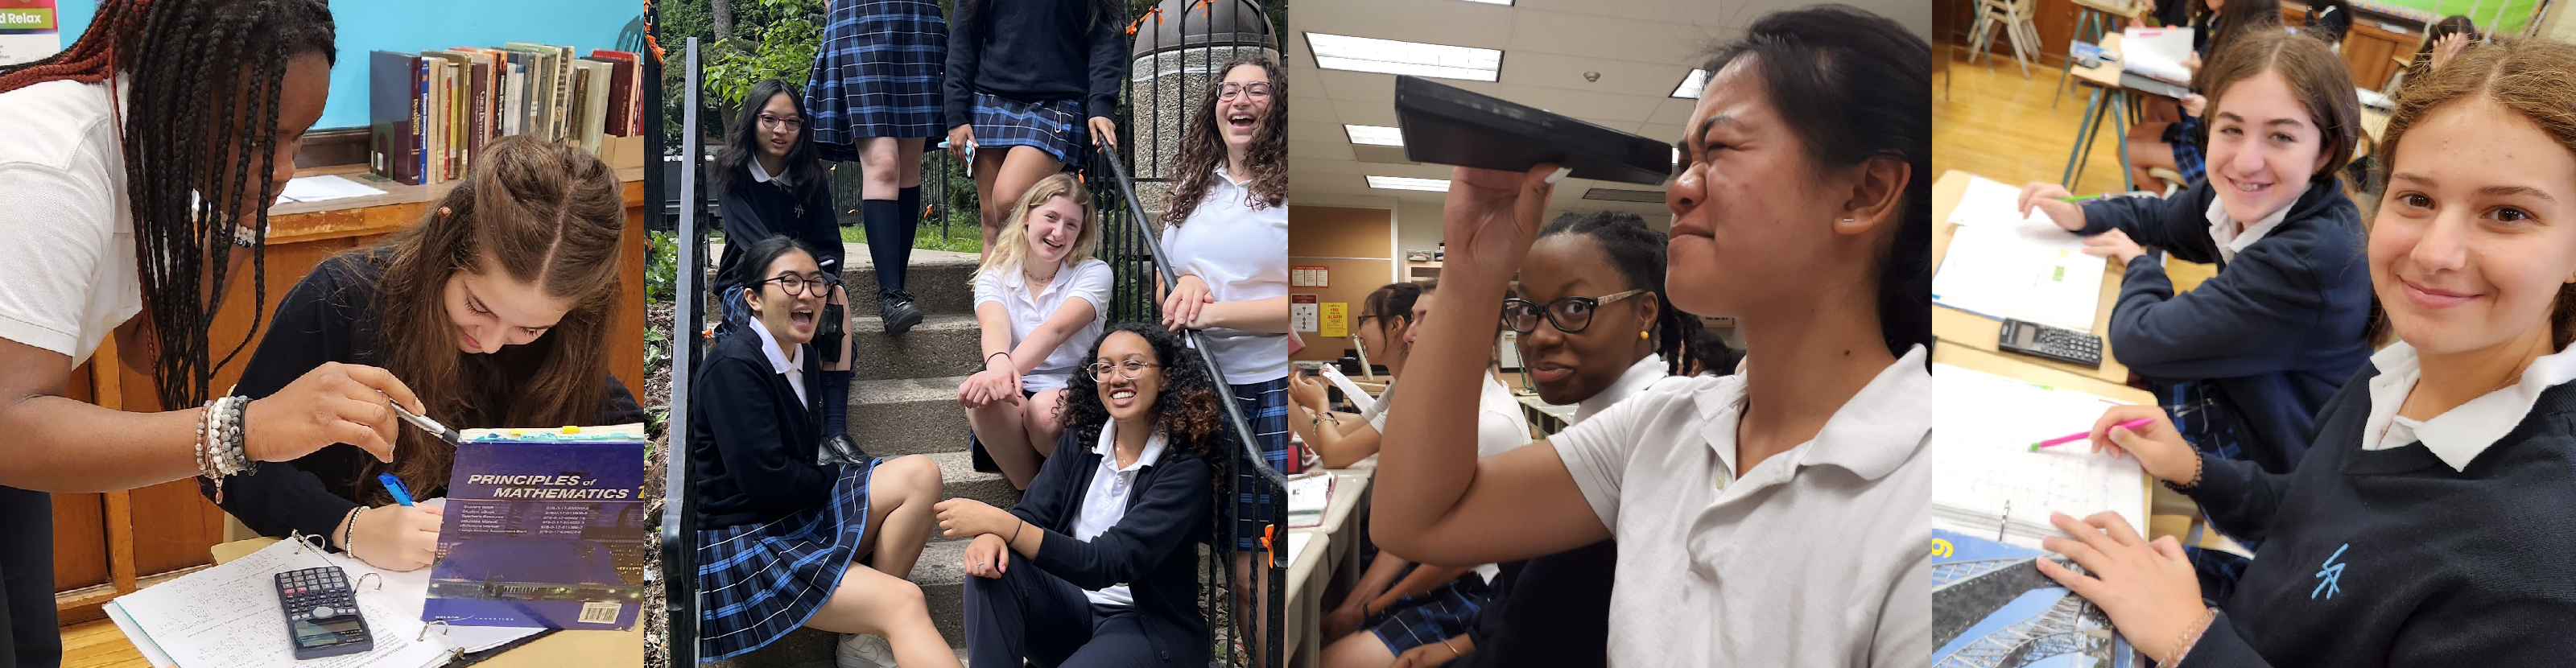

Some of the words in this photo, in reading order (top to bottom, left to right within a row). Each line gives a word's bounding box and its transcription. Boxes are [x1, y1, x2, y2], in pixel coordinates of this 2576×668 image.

[8, 12, 41, 23] Relax
[467, 474, 581, 485] PRINCIPLES
[582, 478, 597, 486] of
[493, 487, 630, 499] MATHEMATICS
